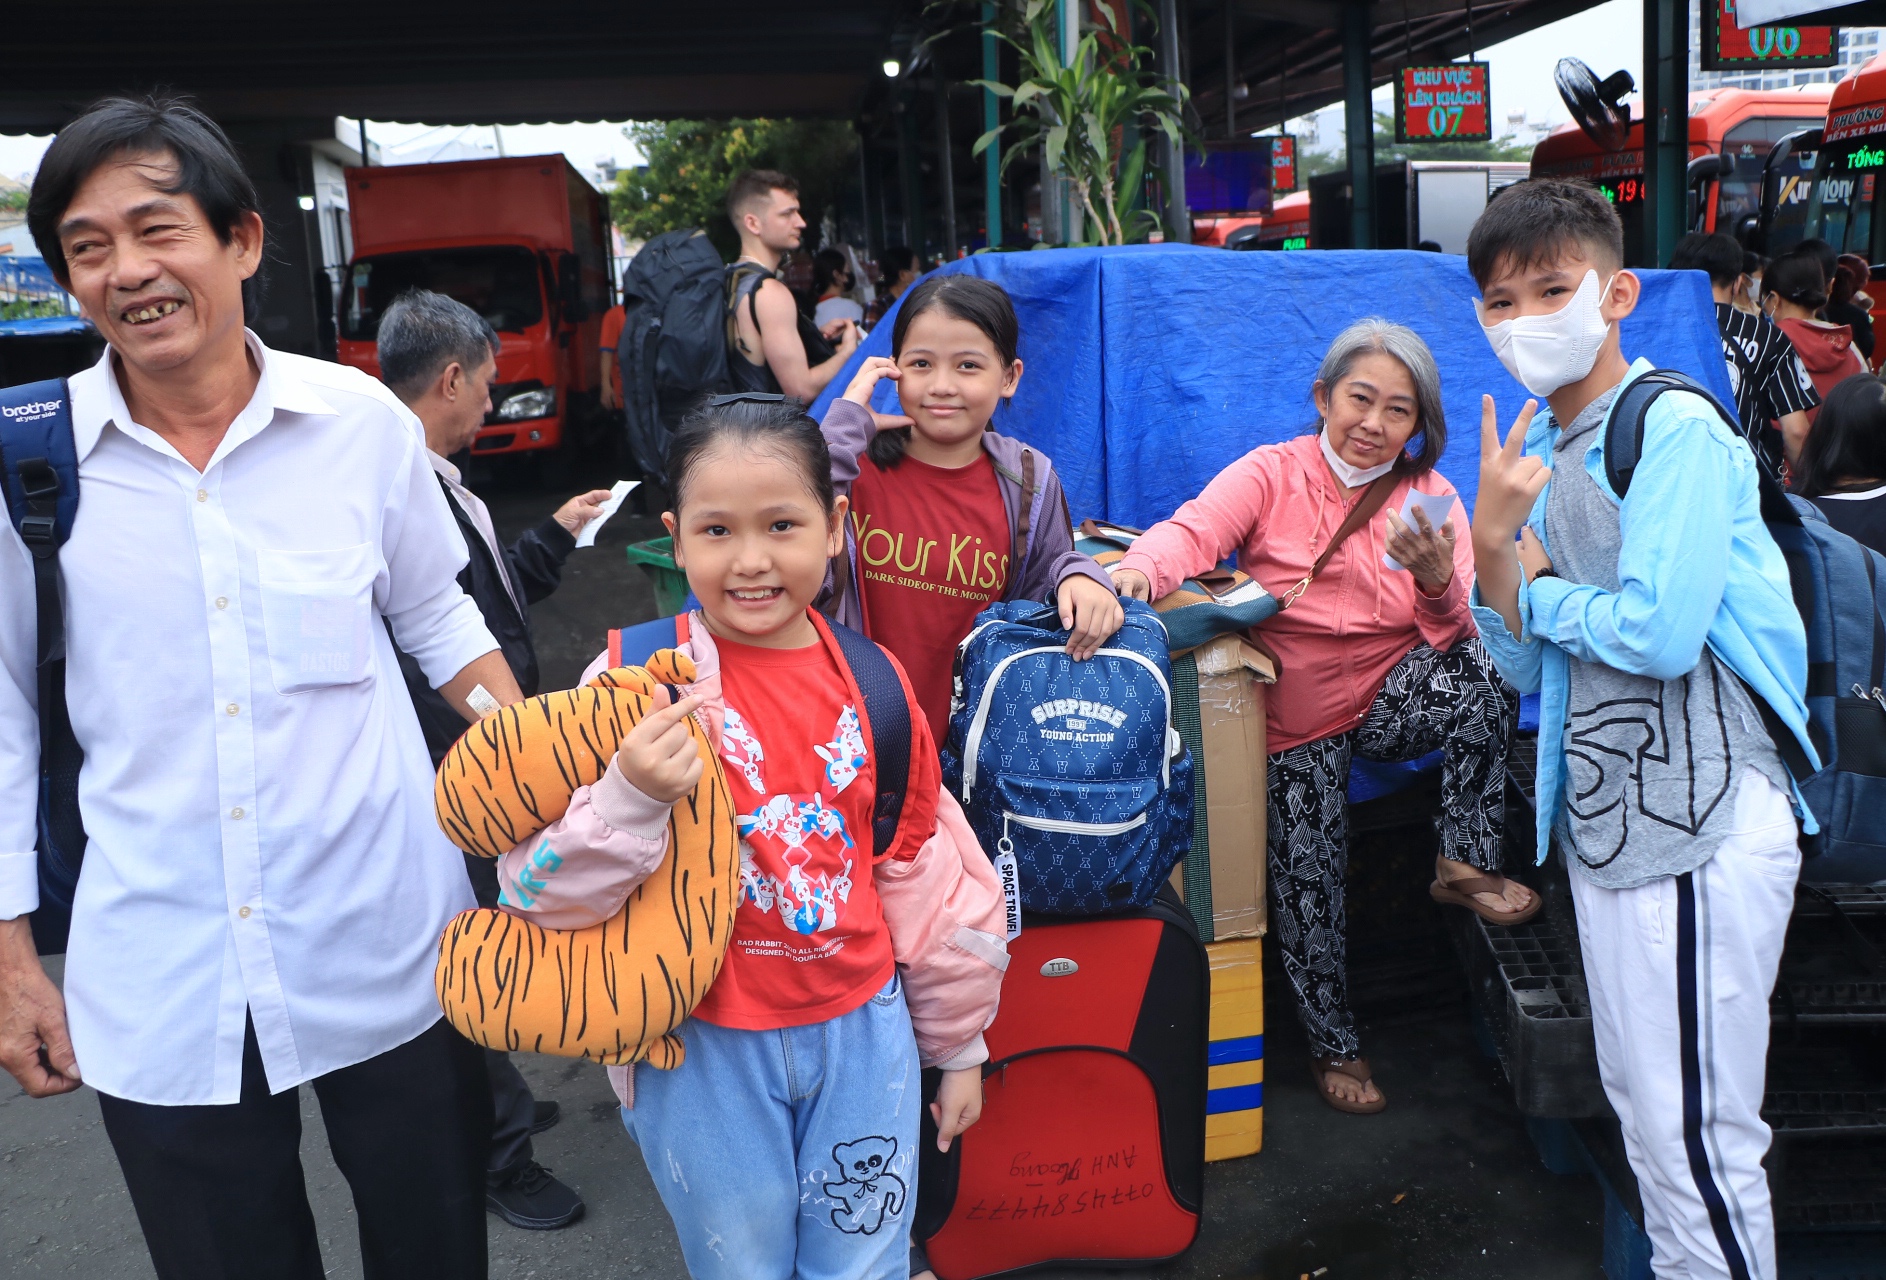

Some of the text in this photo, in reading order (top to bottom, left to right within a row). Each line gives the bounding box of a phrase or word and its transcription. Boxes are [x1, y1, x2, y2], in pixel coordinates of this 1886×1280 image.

[1748, 27, 1801, 57] 06
[1413, 68, 1472, 88] KHU VỰC
[1408, 86, 1482, 107] LÊN KHÁCH
[1427, 105, 1464, 137] 07
[1849, 126, 1867, 138] XE
[1847, 144, 1885, 169] TỔNG
[1617, 179, 1637, 202] 19
[2, 400, 62, 418] brother
[865, 569, 895, 584] DARK
[937, 584, 958, 597] THE
[959, 590, 991, 602] MOON
[301, 652, 350, 673] BASTOS
[1031, 698, 1128, 729] SURPRISE
[1040, 729, 1114, 743] YOUNG ACTION
[1002, 863, 1017, 934] SPACE TRAVEL
[745, 948, 784, 956] DESIGNED
[754, 940, 783, 948] RABBIT
[1049, 961, 1070, 972] TTB
[1091, 1145, 1138, 1176] ANH
[965, 1183, 1154, 1221] 0774584477
